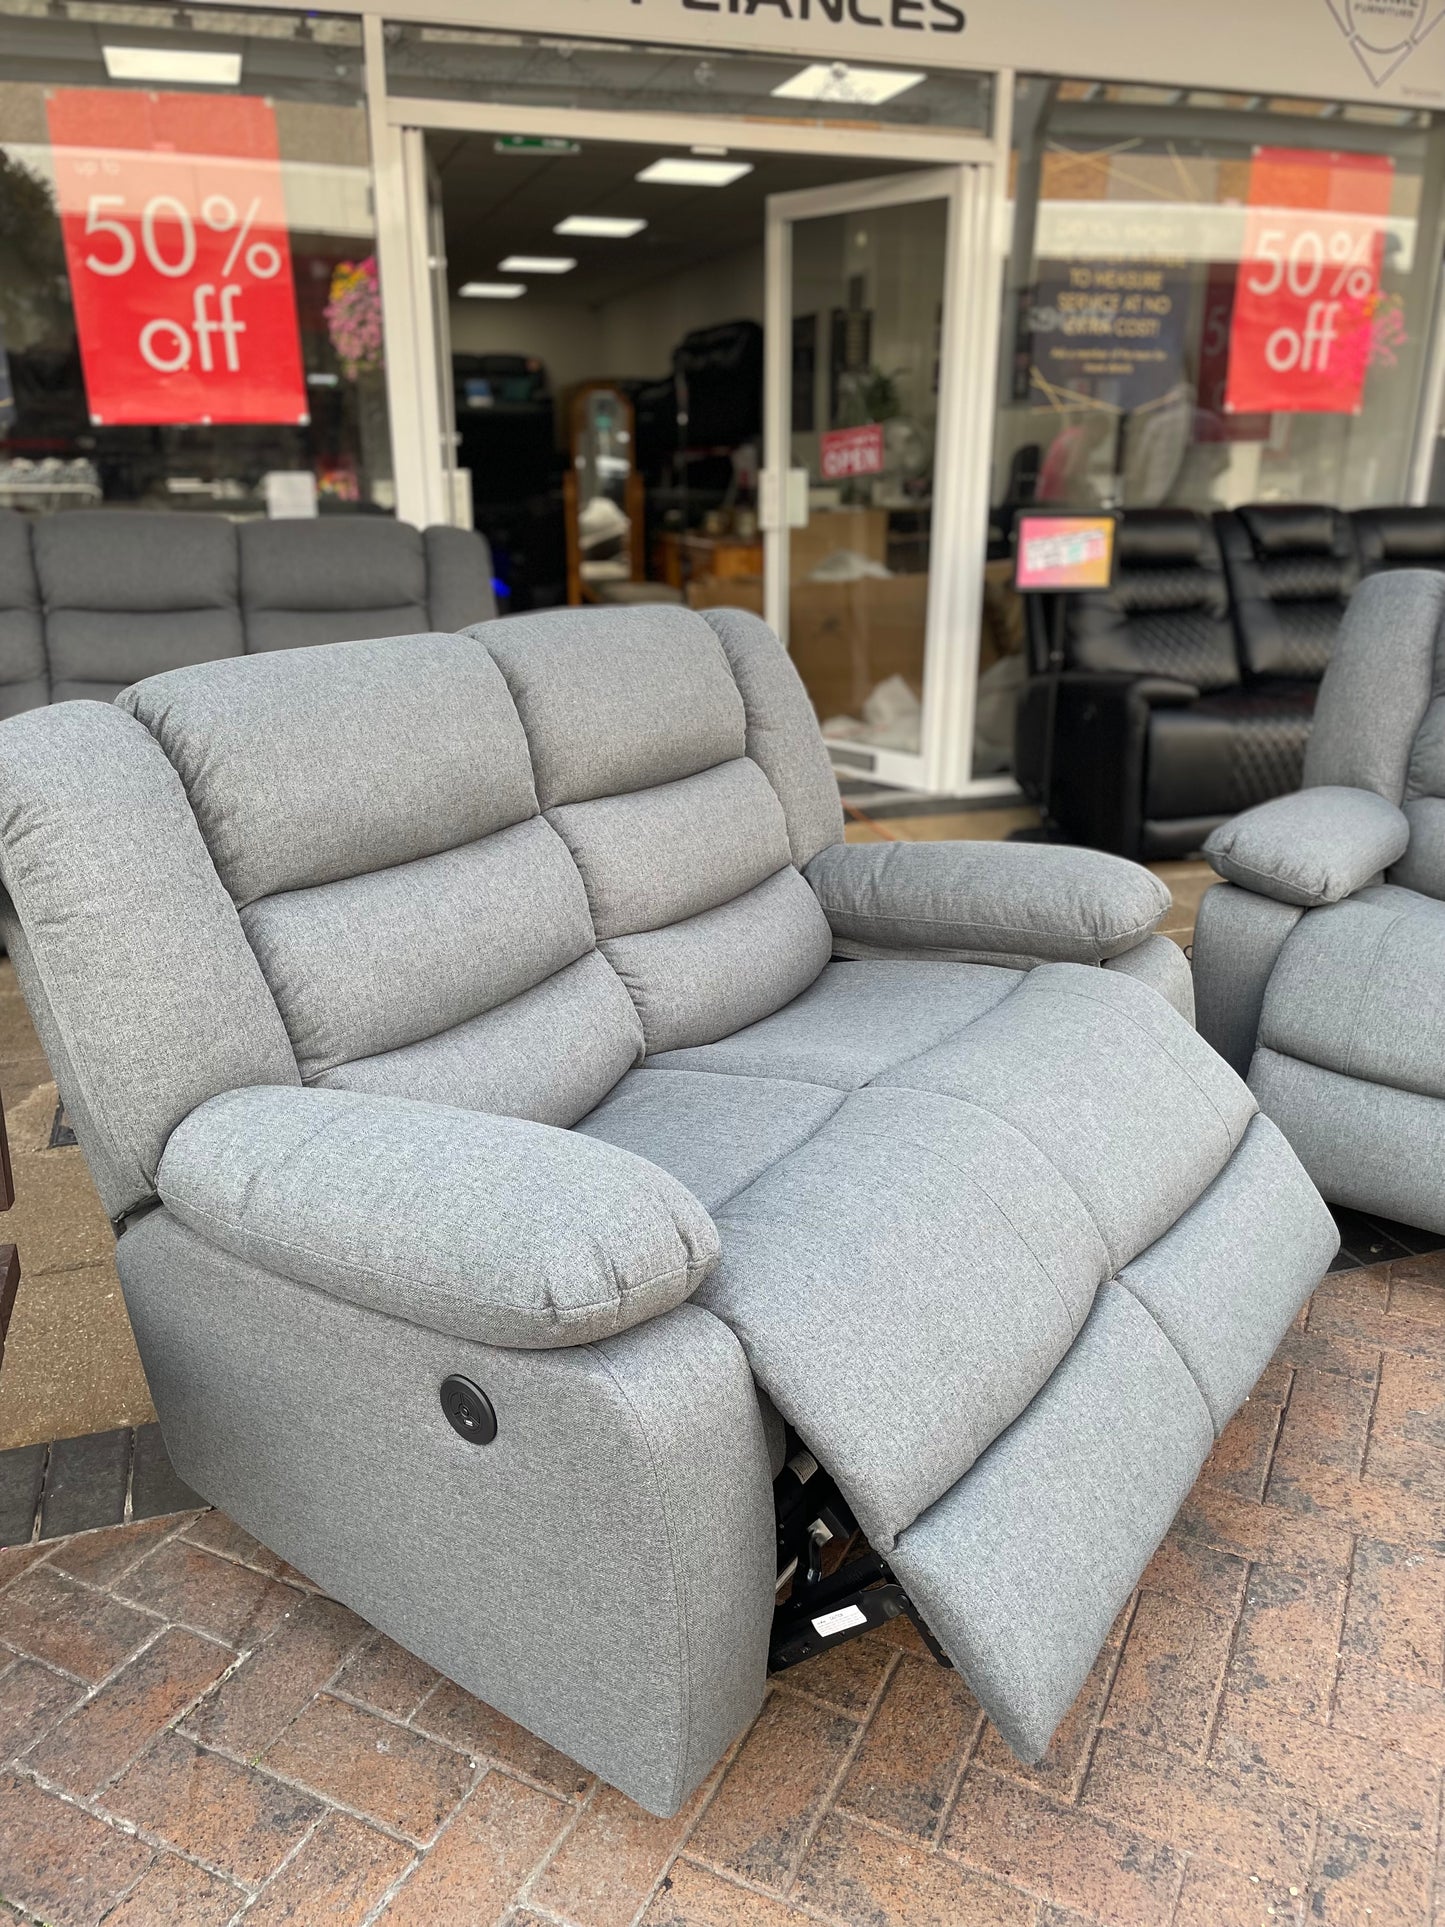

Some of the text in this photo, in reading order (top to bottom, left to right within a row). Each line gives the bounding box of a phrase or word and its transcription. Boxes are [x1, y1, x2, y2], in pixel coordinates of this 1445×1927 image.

[85, 194, 282, 279] 50%
[1247, 229, 1373, 299] 50%
[1056, 291, 1172, 316] SERVICE AT NO
[1069, 267, 1163, 290] TO MEASURE
[138, 283, 247, 373] off
[1264, 300, 1342, 373] off
[824, 447, 879, 475] OPEN
